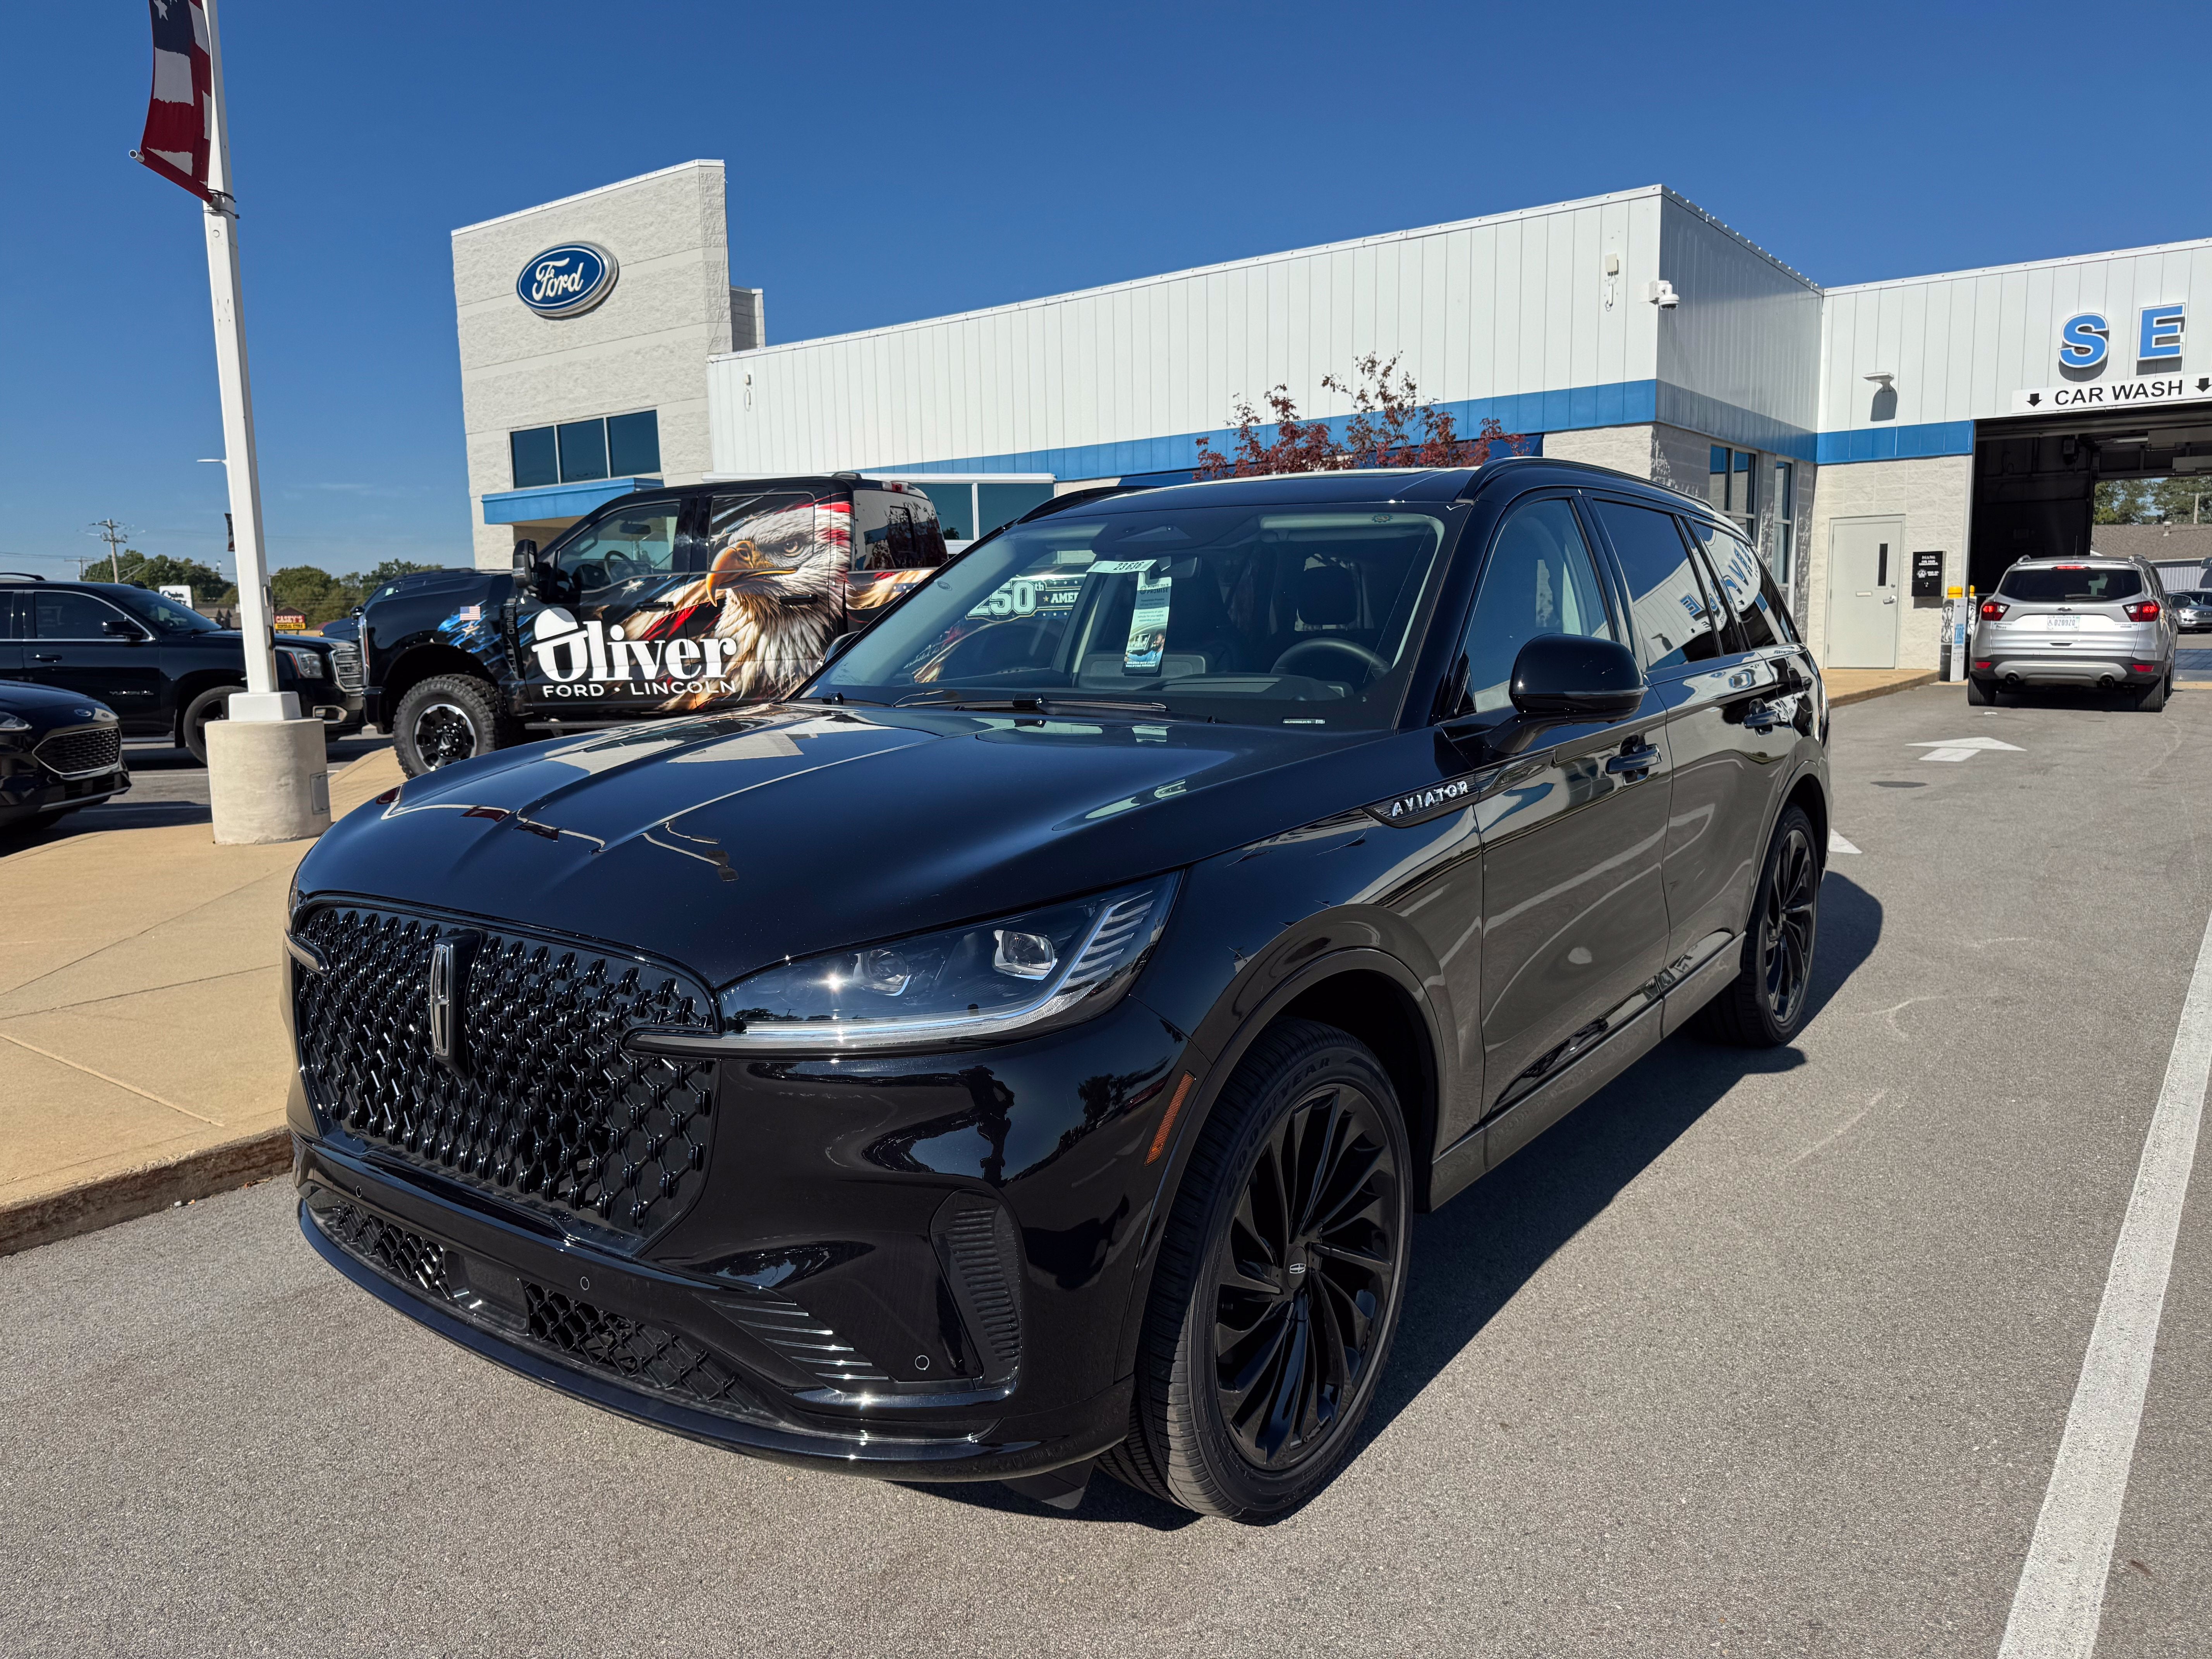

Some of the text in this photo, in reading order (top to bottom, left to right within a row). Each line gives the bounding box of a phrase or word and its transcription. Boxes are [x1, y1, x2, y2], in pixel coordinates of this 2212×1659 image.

[532, 257, 584, 301] Ford
[2055, 380, 2183, 405] CAR WASH
[1113, 562, 1145, 570] 23636
[531, 607, 737, 682] Oliver
[543, 681, 736, 697] FORD LINCOLN
[1392, 780, 1469, 817] AVIATOR
